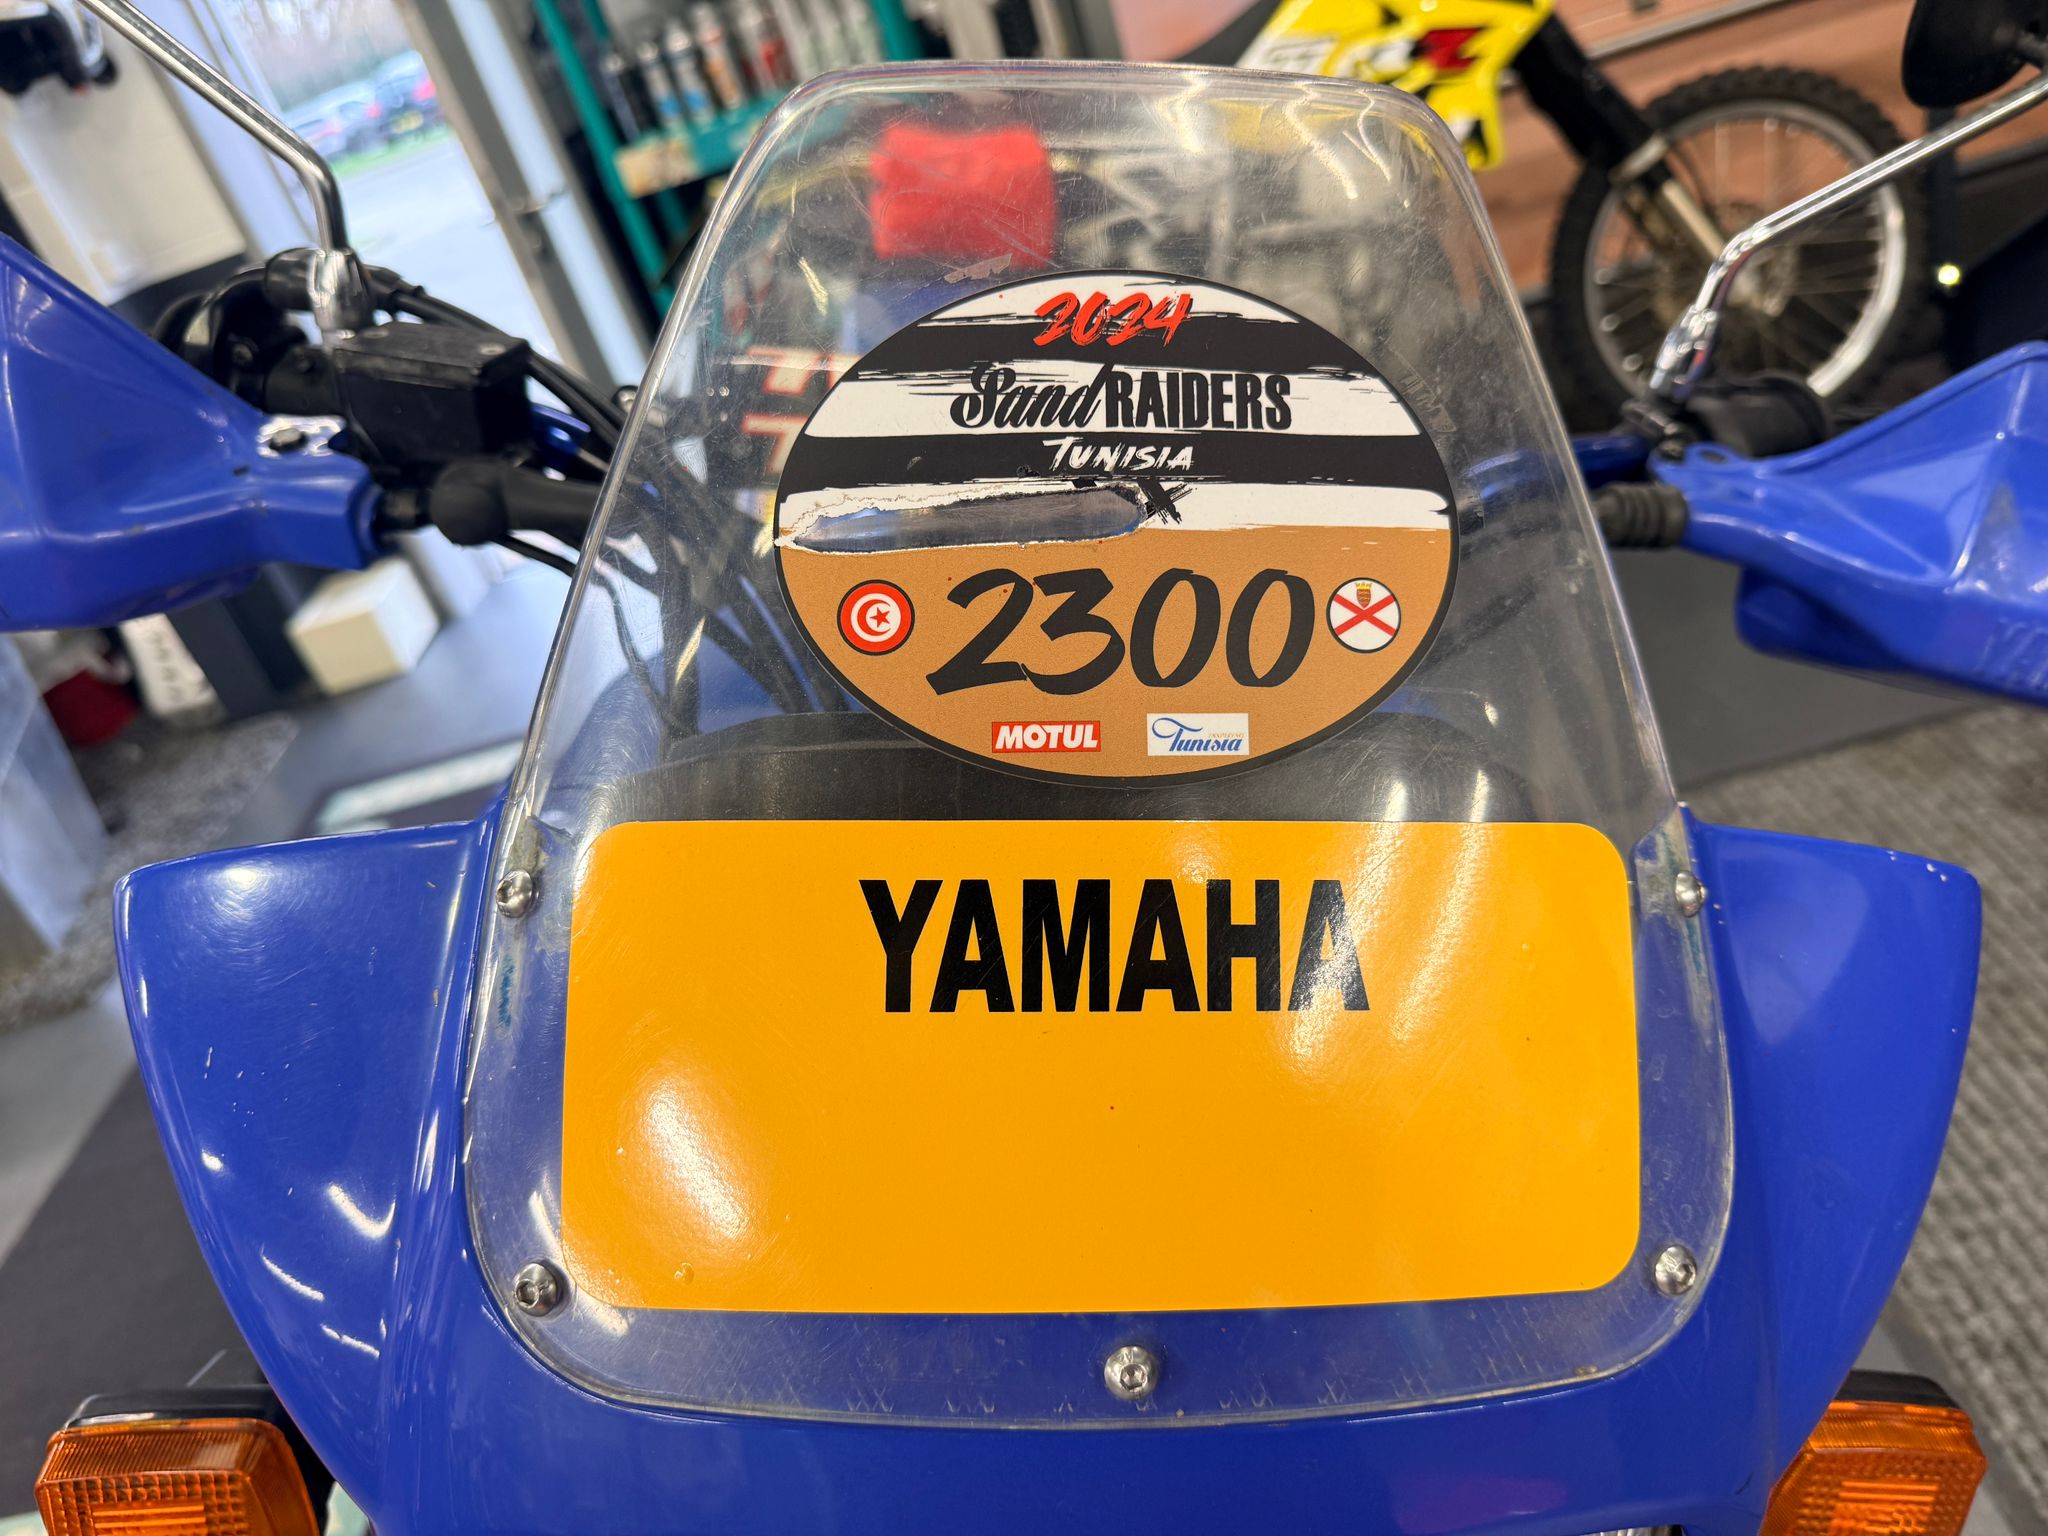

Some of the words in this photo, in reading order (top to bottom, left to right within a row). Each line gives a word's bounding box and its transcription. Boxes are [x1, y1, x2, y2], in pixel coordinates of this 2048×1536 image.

[1033, 290, 1190, 346] 2024
[949, 363, 1114, 428] Sand
[1105, 370, 1292, 430] RAIDERS
[926, 568, 1315, 695] 2300
[995, 723, 1098, 750] MOTUL
[1151, 717, 1243, 751] Tunisia
[859, 879, 1370, 1012] YAMAHA
